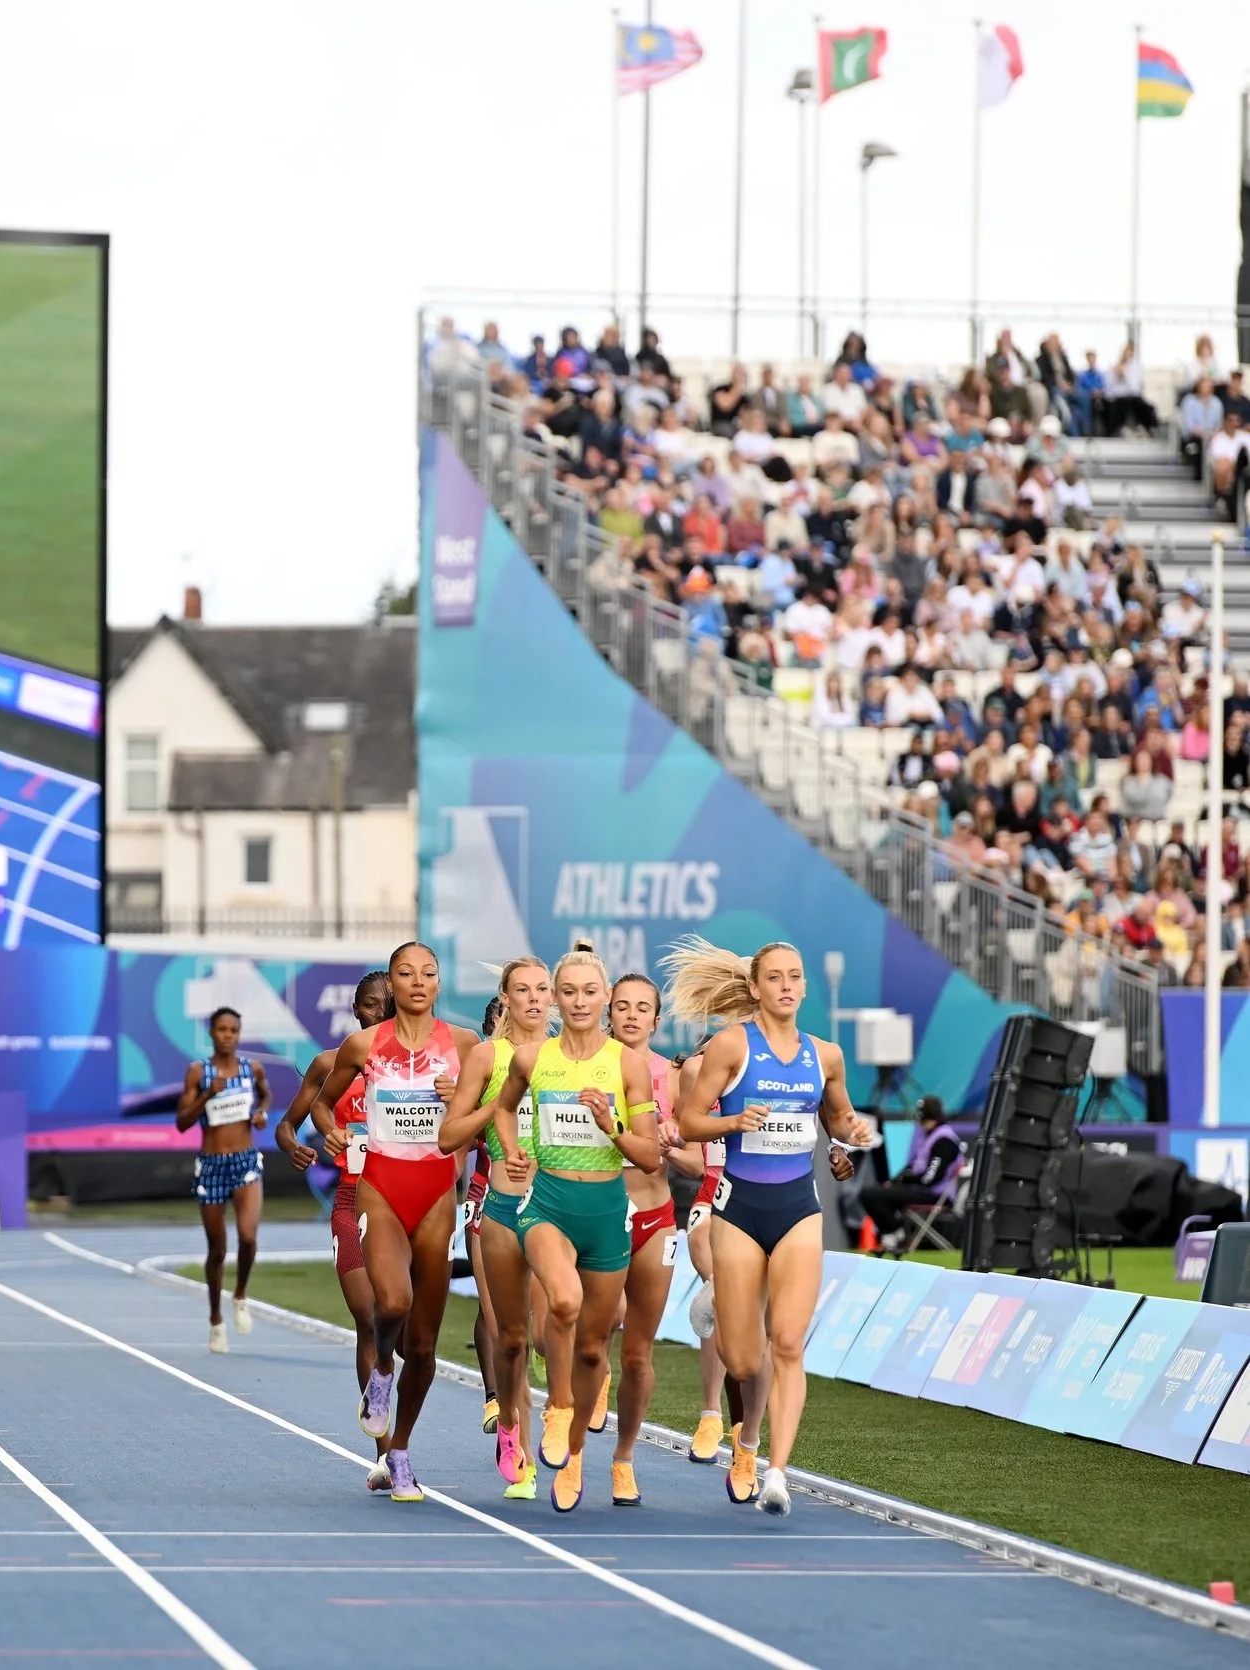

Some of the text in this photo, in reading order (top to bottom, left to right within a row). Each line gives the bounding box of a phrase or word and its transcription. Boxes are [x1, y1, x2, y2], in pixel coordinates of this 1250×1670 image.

[553, 861, 720, 919] ATHLETICS
[377, 1060, 403, 1070] KUKRI
[540, 1070, 566, 1078] VALOUR
[757, 1079, 815, 1093] SCOTLAND
[385, 1106, 443, 1116] WALCOTT-
[395, 1119, 434, 1127] NOLAN
[555, 1113, 590, 1124] HULL
[758, 1122, 803, 1132] REEKIE
[552, 1131, 593, 1140] LONGINES
[762, 1140, 801, 1148] LONGINES
[715, 1181, 725, 1200] 5
